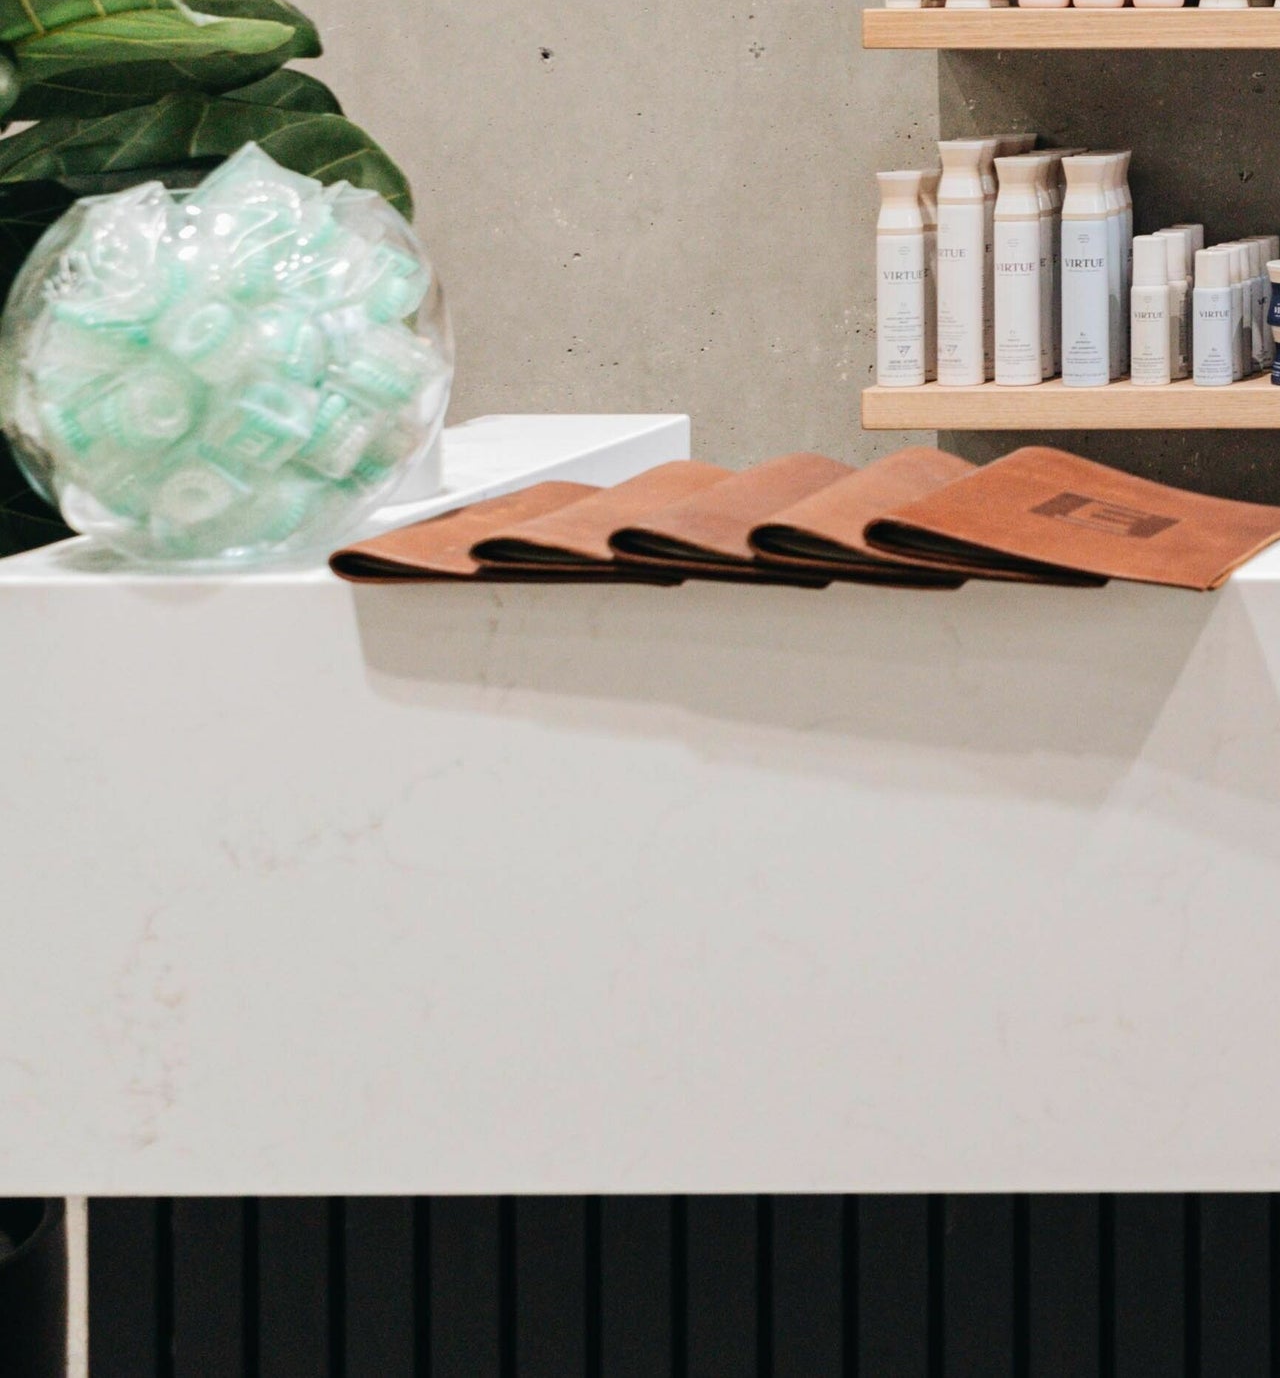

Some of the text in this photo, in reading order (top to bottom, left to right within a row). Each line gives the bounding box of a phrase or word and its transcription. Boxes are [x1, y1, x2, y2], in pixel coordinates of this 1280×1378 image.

[938, 248, 966, 258] RTUE
[1064, 258, 1104, 268] VIRTUE
[1199, 310, 1230, 318] VIRTUE
